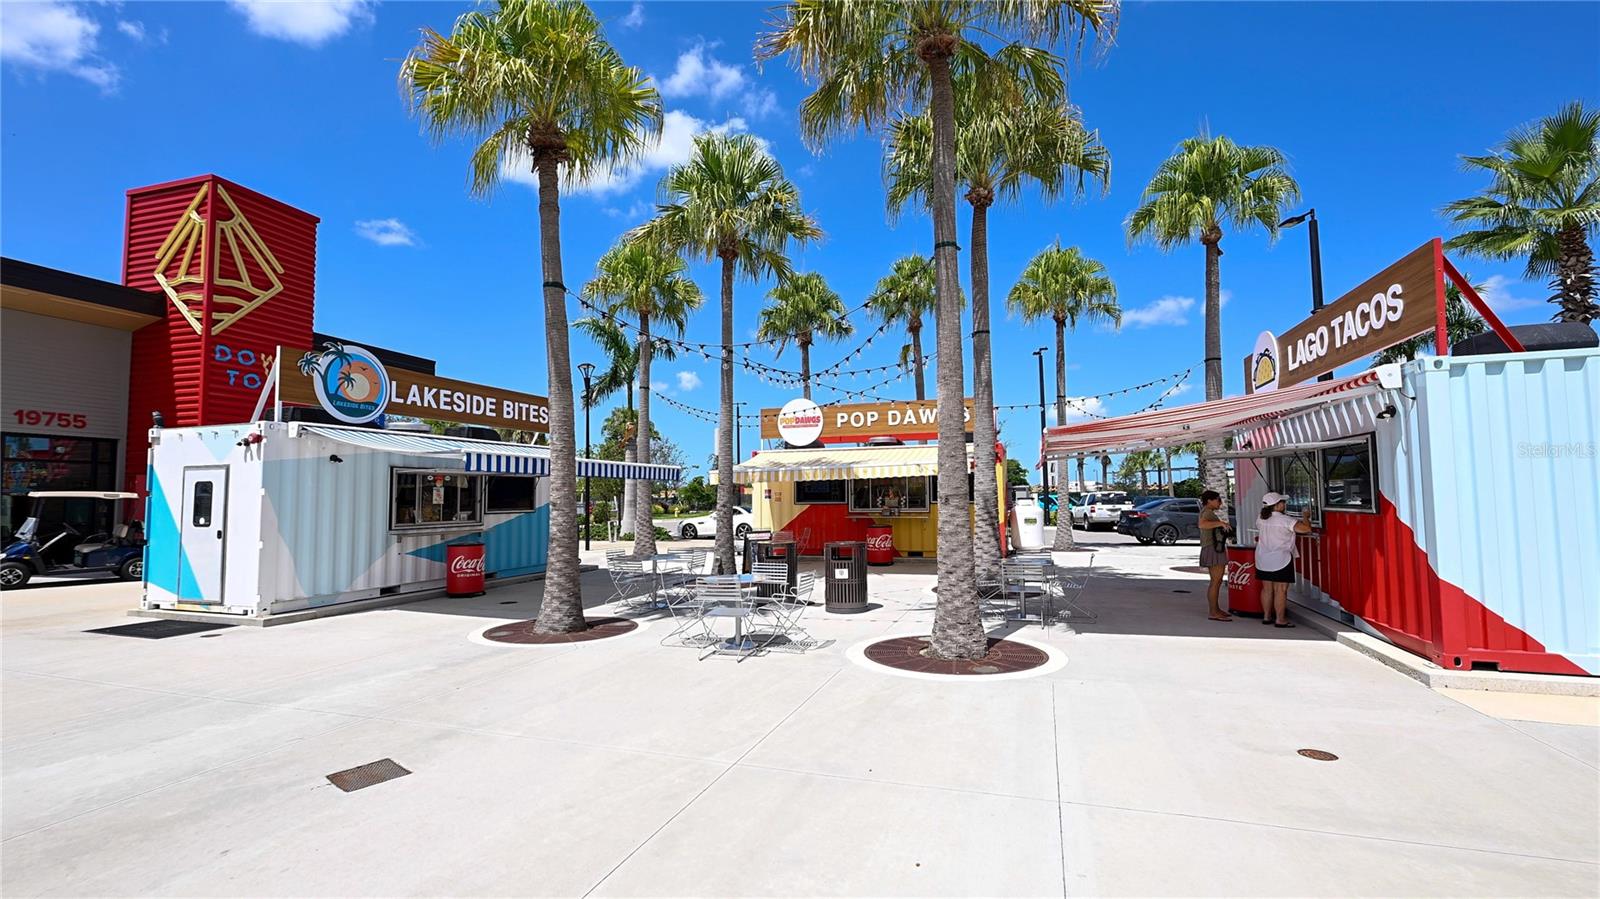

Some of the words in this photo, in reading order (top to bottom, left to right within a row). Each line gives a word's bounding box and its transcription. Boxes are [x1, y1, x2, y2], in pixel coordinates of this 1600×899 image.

[1287, 326, 1329, 371] LAGO
[1331, 284, 1404, 348] TACOS
[391, 381, 497, 417] LAKESIDE
[503, 400, 549, 424] BITES
[836, 411, 879, 428] POP
[887, 406, 971, 426] DAWS
[14, 409, 87, 429] 19755
